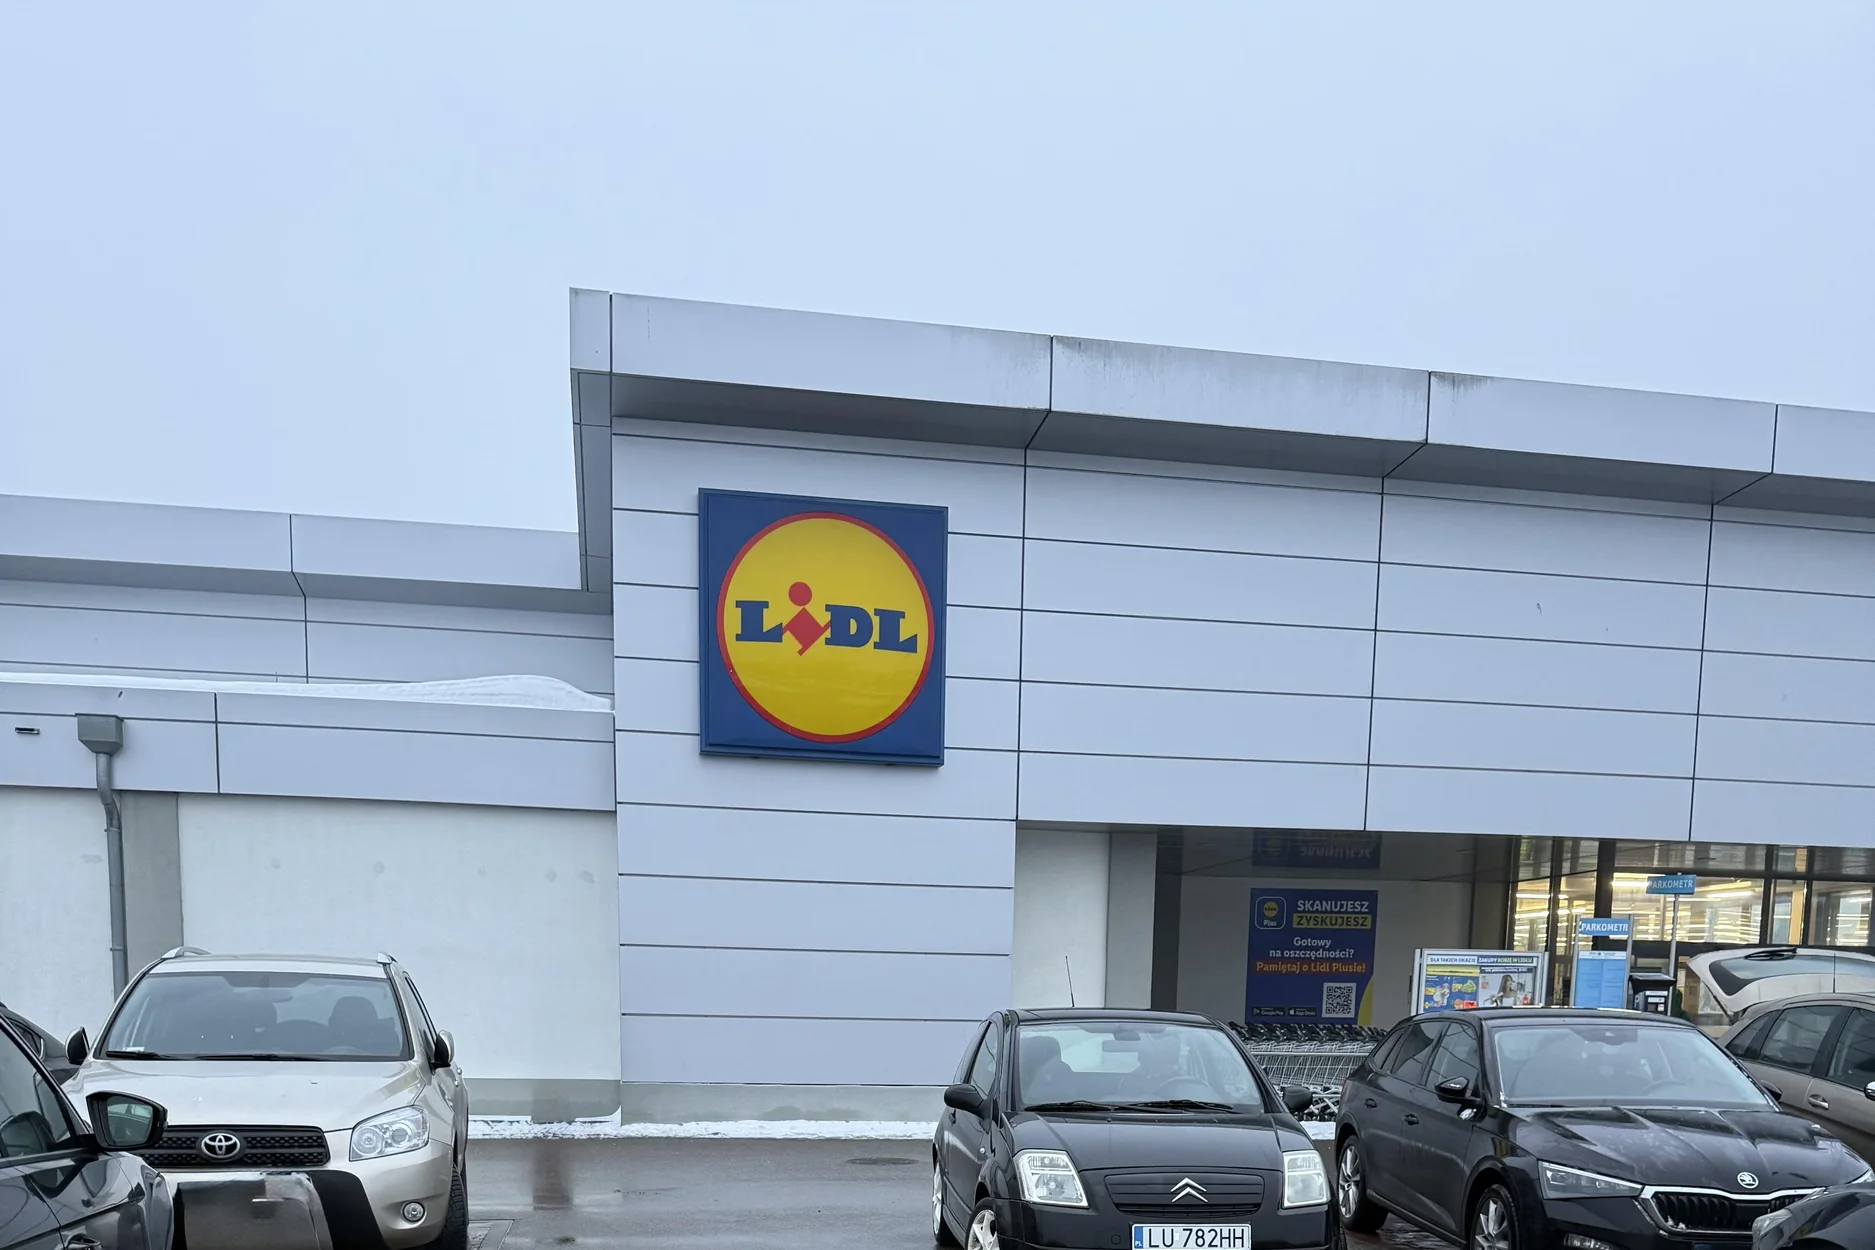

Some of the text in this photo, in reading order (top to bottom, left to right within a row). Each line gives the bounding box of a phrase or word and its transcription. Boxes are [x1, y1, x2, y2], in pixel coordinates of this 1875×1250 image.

[1648, 879, 1694, 889] PARKOMETR
[1297, 900, 1369, 912] SKANUJESZ
[1263, 919, 1277, 927] Plus
[1296, 915, 1368, 927] ZYSKUJESZ
[1581, 923, 1629, 932] PARKOMETR
[1293, 937, 1332, 948] Gotowy
[1283, 948, 1355, 960] oszczędności?
[1256, 962, 1300, 973] Pamiętaj
[1311, 962, 1330, 972] Lidl
[1332, 963, 1366, 973] Plusie!
[1148, 1228, 1245, 1248] LU 782HH
